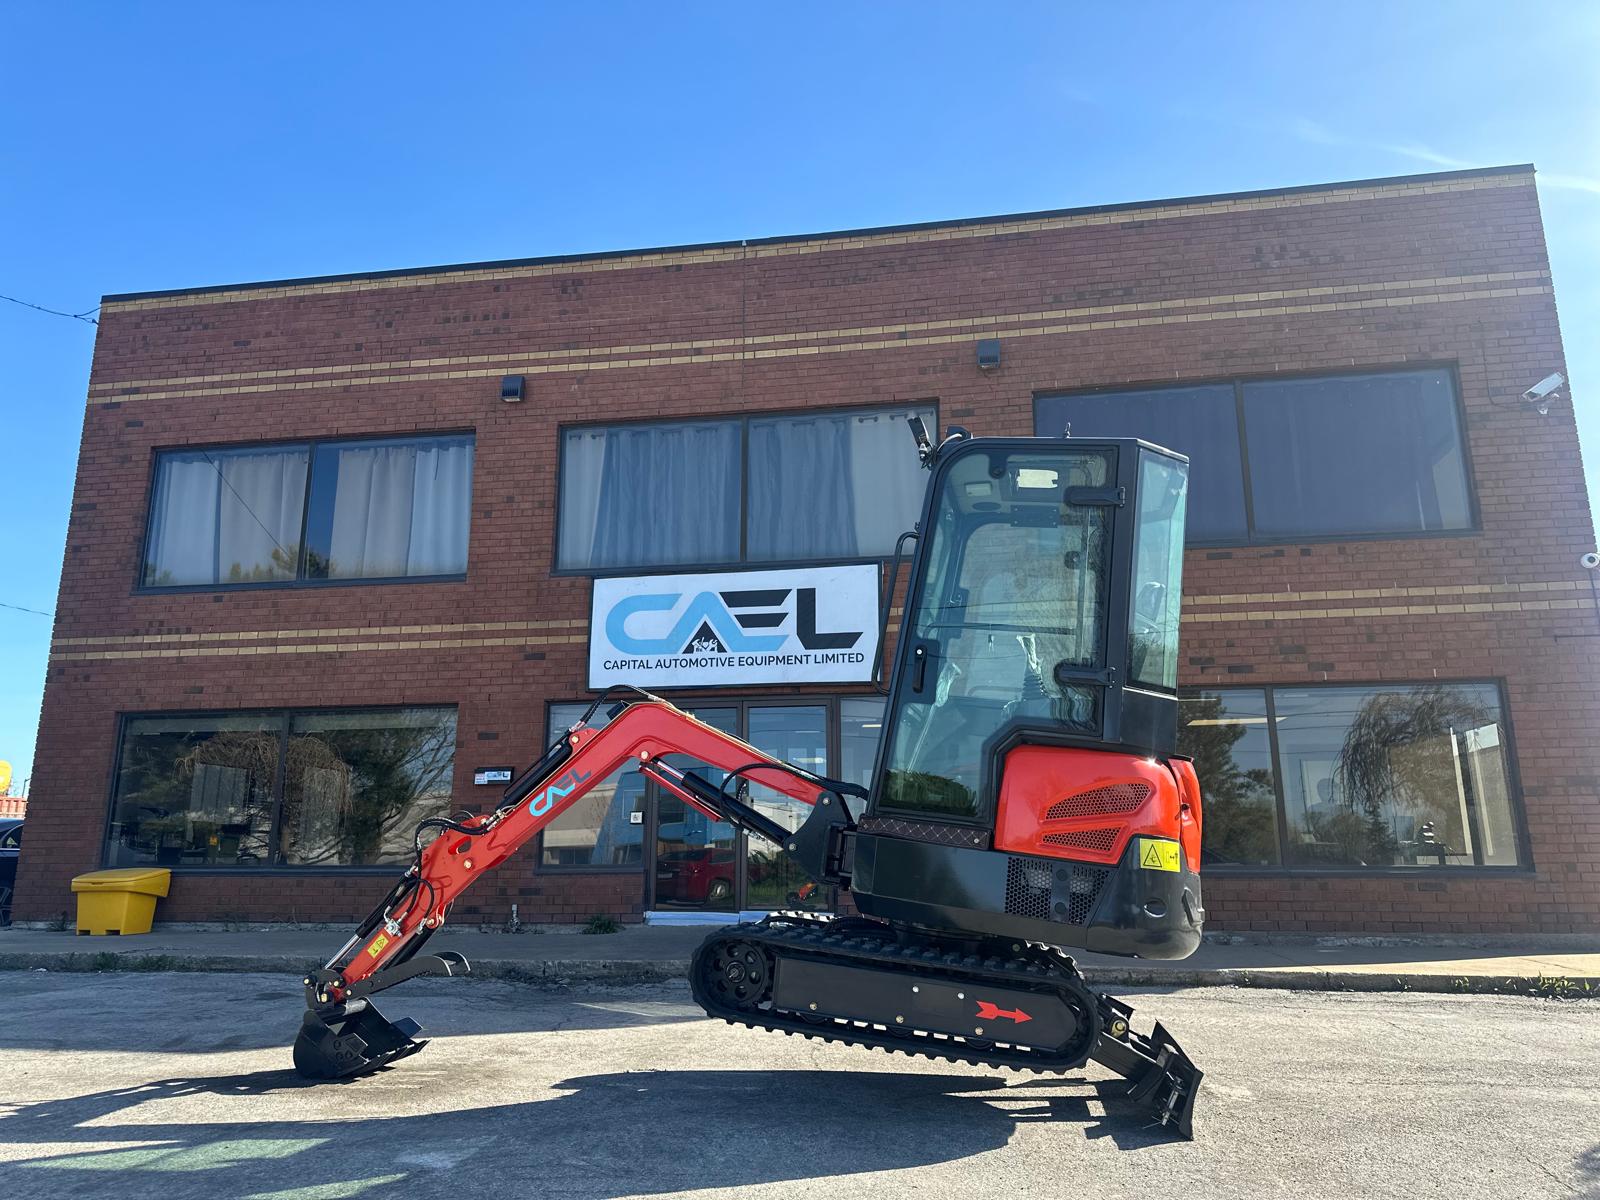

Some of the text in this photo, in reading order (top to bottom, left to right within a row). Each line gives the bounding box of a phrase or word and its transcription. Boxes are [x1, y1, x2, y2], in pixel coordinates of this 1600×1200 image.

[605, 588, 864, 655] CAEL
[603, 652, 865, 670] CAPITAL AUTOMOTIVE EQUIPMENT LIMITED
[529, 768, 592, 817] CAEL
